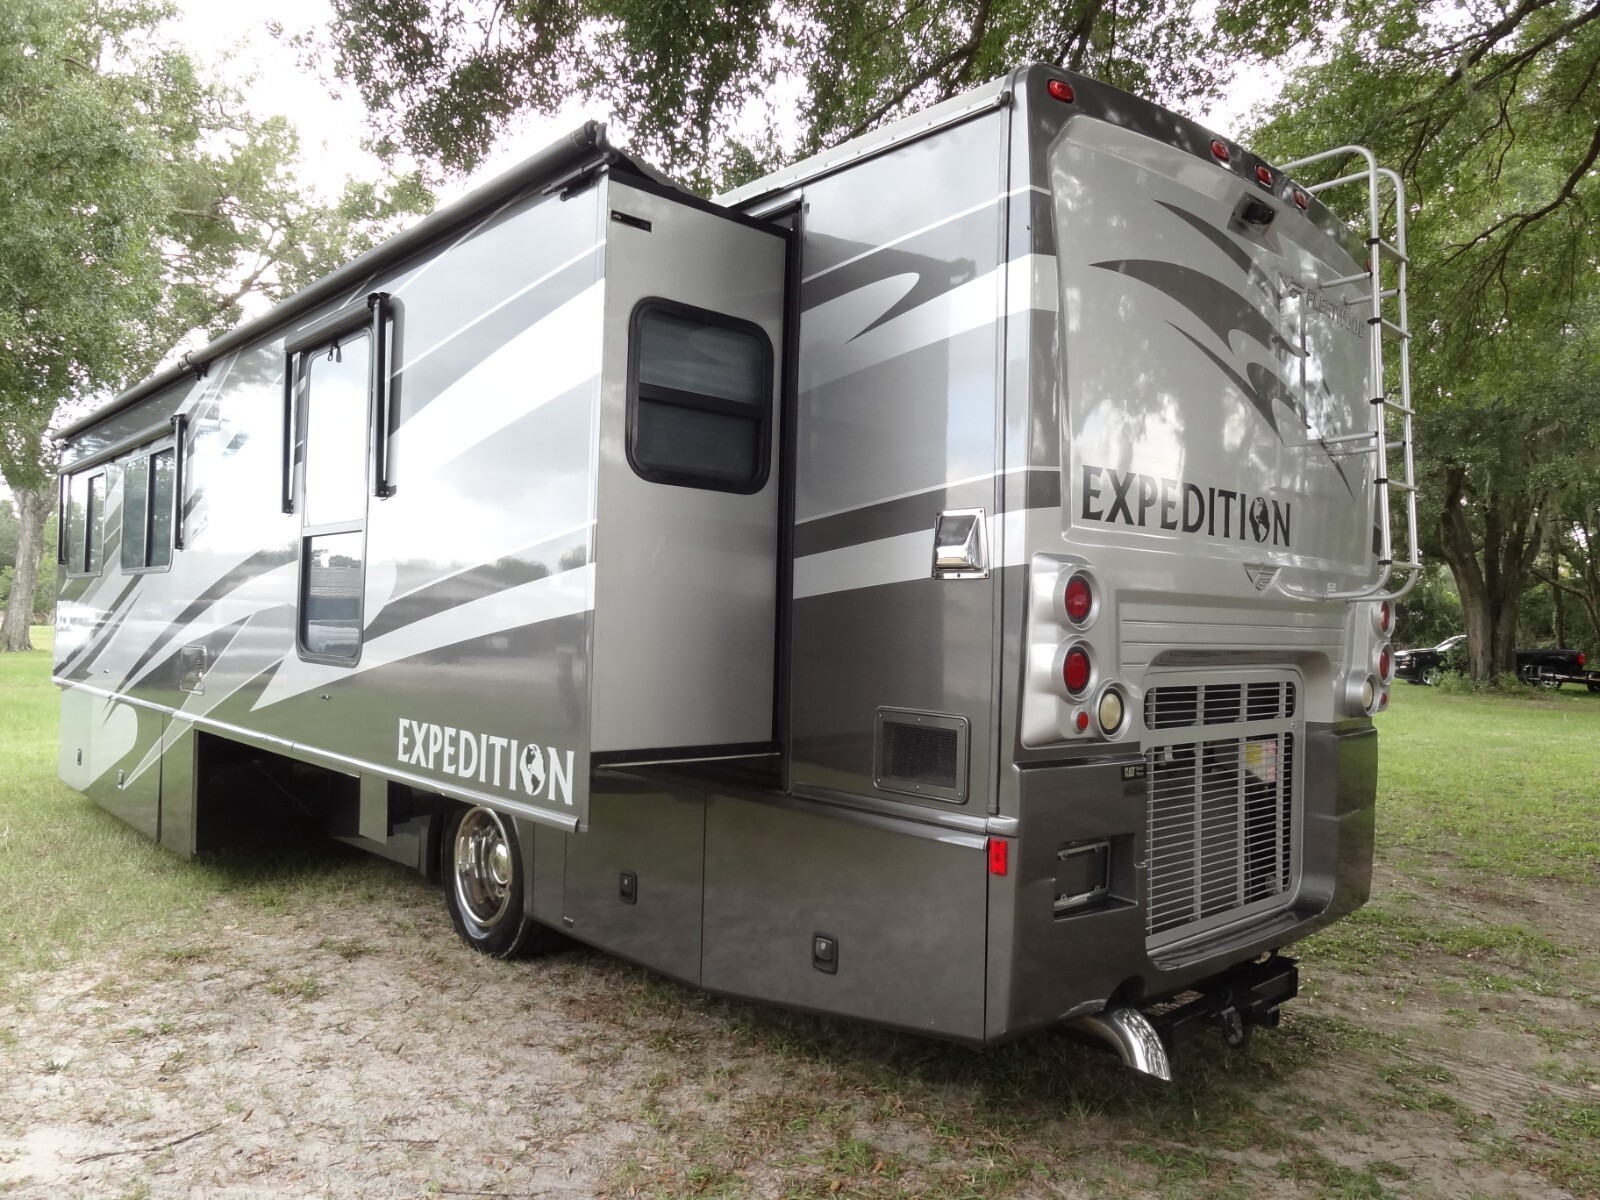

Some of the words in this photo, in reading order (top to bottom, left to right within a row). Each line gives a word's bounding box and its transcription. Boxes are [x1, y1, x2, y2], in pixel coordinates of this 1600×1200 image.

[1305, 288, 1365, 338] FLEETWOOD
[1081, 464, 1291, 547] EXPEDITION
[397, 717, 575, 806] EXPEDITION
